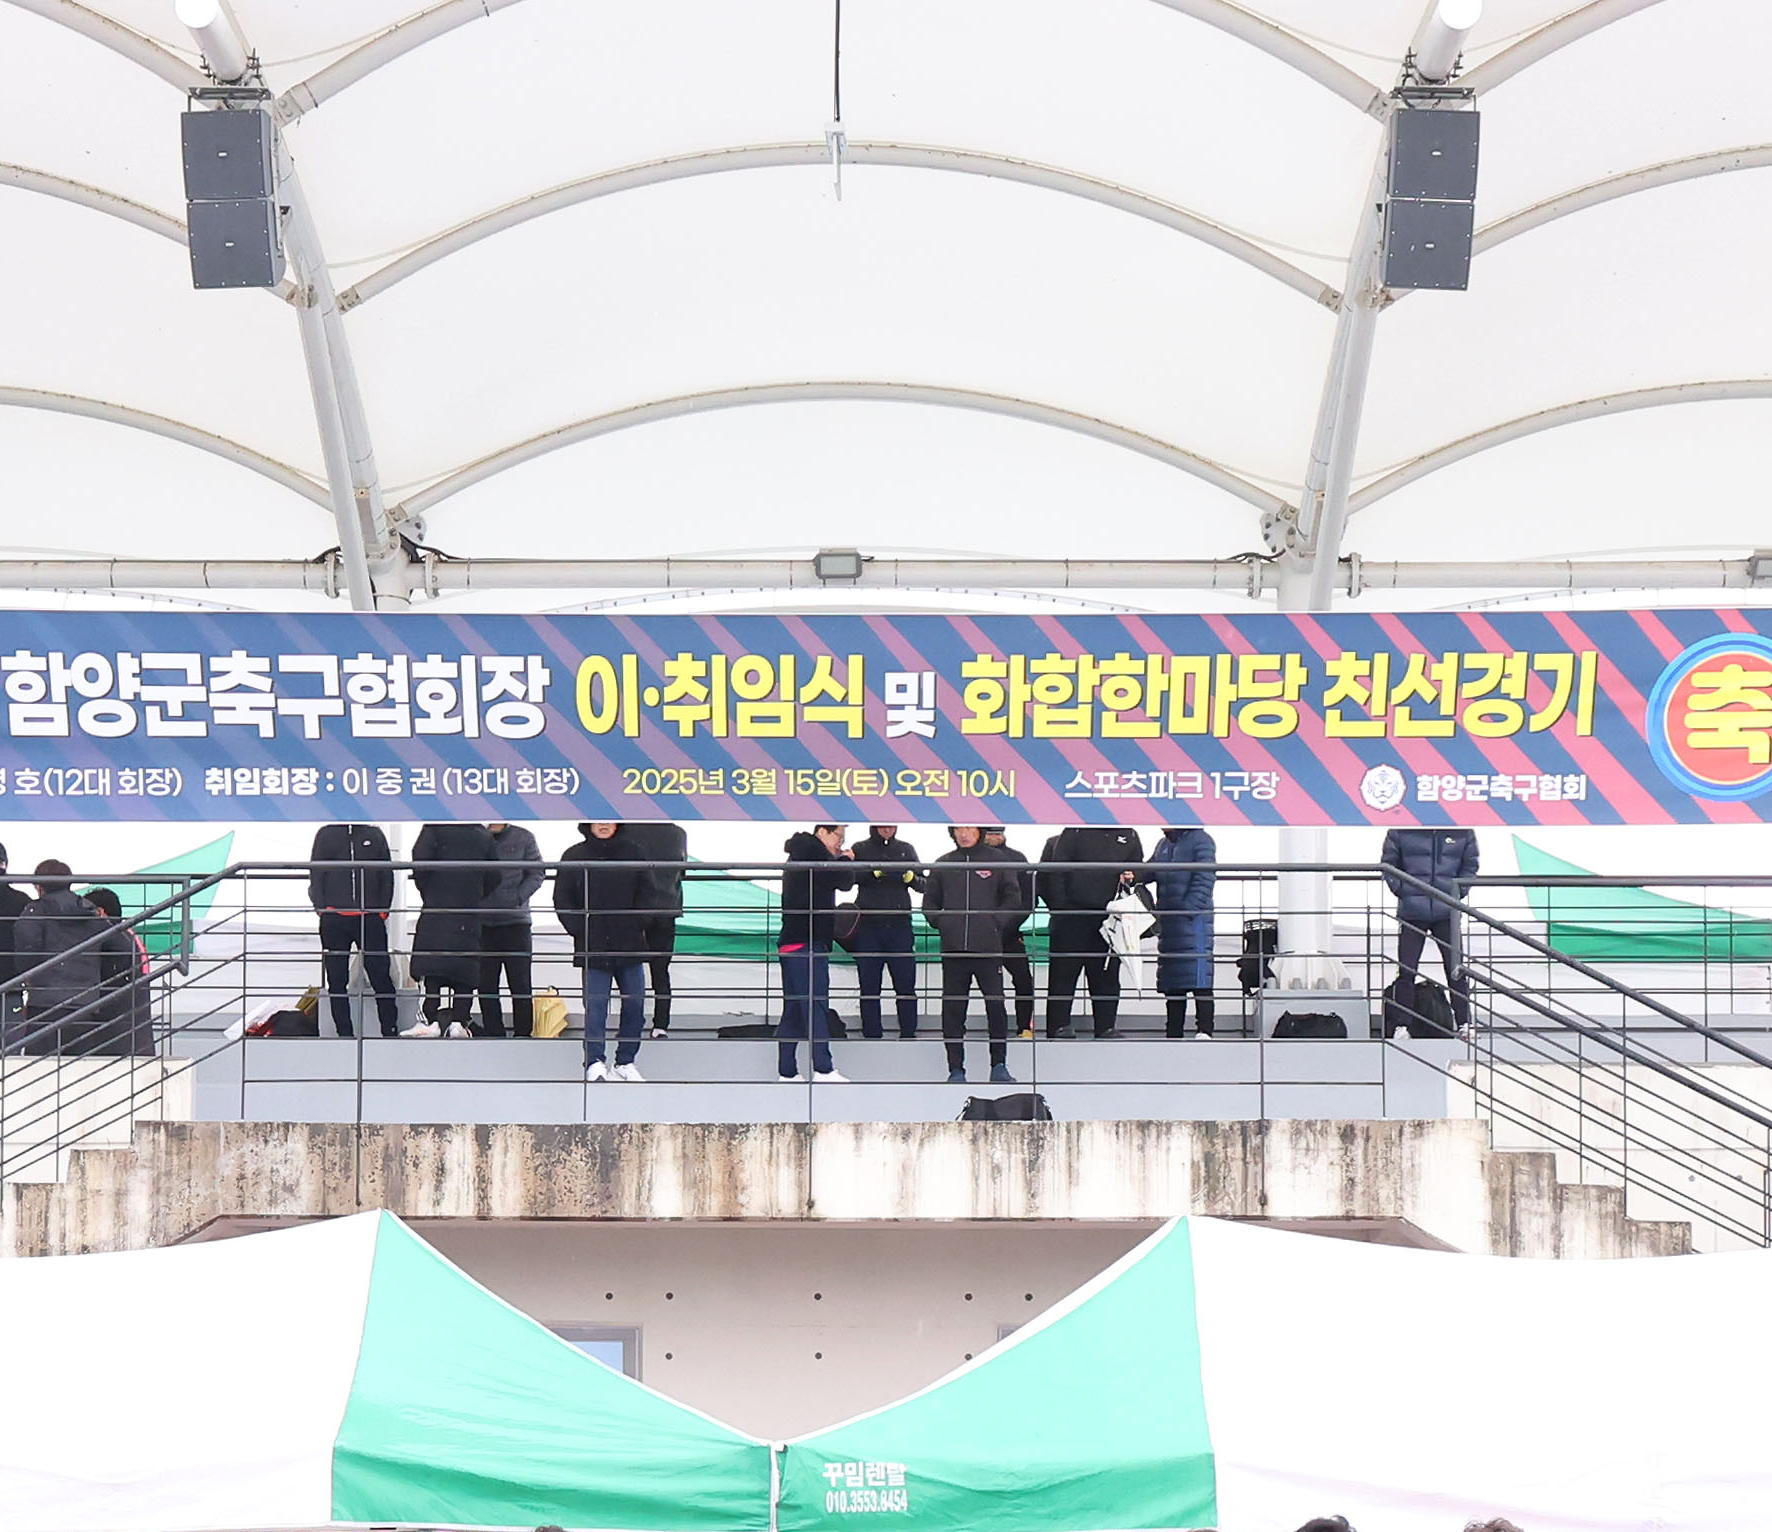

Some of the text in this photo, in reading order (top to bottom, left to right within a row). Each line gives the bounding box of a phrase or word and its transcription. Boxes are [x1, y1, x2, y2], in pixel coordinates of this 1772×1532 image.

[0, 650, 550, 739] 함양군축구협회장
[884, 671, 936, 739] 및
[960, 652, 1308, 738] 화합한마당
[1323, 650, 1597, 738] 친선경기
[14, 767, 111, 797] 호(12대
[117, 767, 183, 797] 회장)
[205, 767, 320, 796] 취임회장
[342, 767, 368, 796] 이
[375, 768, 403, 795] 중
[409, 767, 437, 795] 권
[442, 767, 509, 796] (13대
[515, 767, 580, 796] 회장)
[622, 768, 1015, 798] 2025년 3월 15일(토) 오전 10시
[1064, 770, 1281, 801] 스포츠파크 1구장
[1416, 773, 1587, 802] 함양군축구협회
[822, 1461, 908, 1488] 꾸밈렌탈
[825, 1489, 909, 1514] 010.3553.8454
